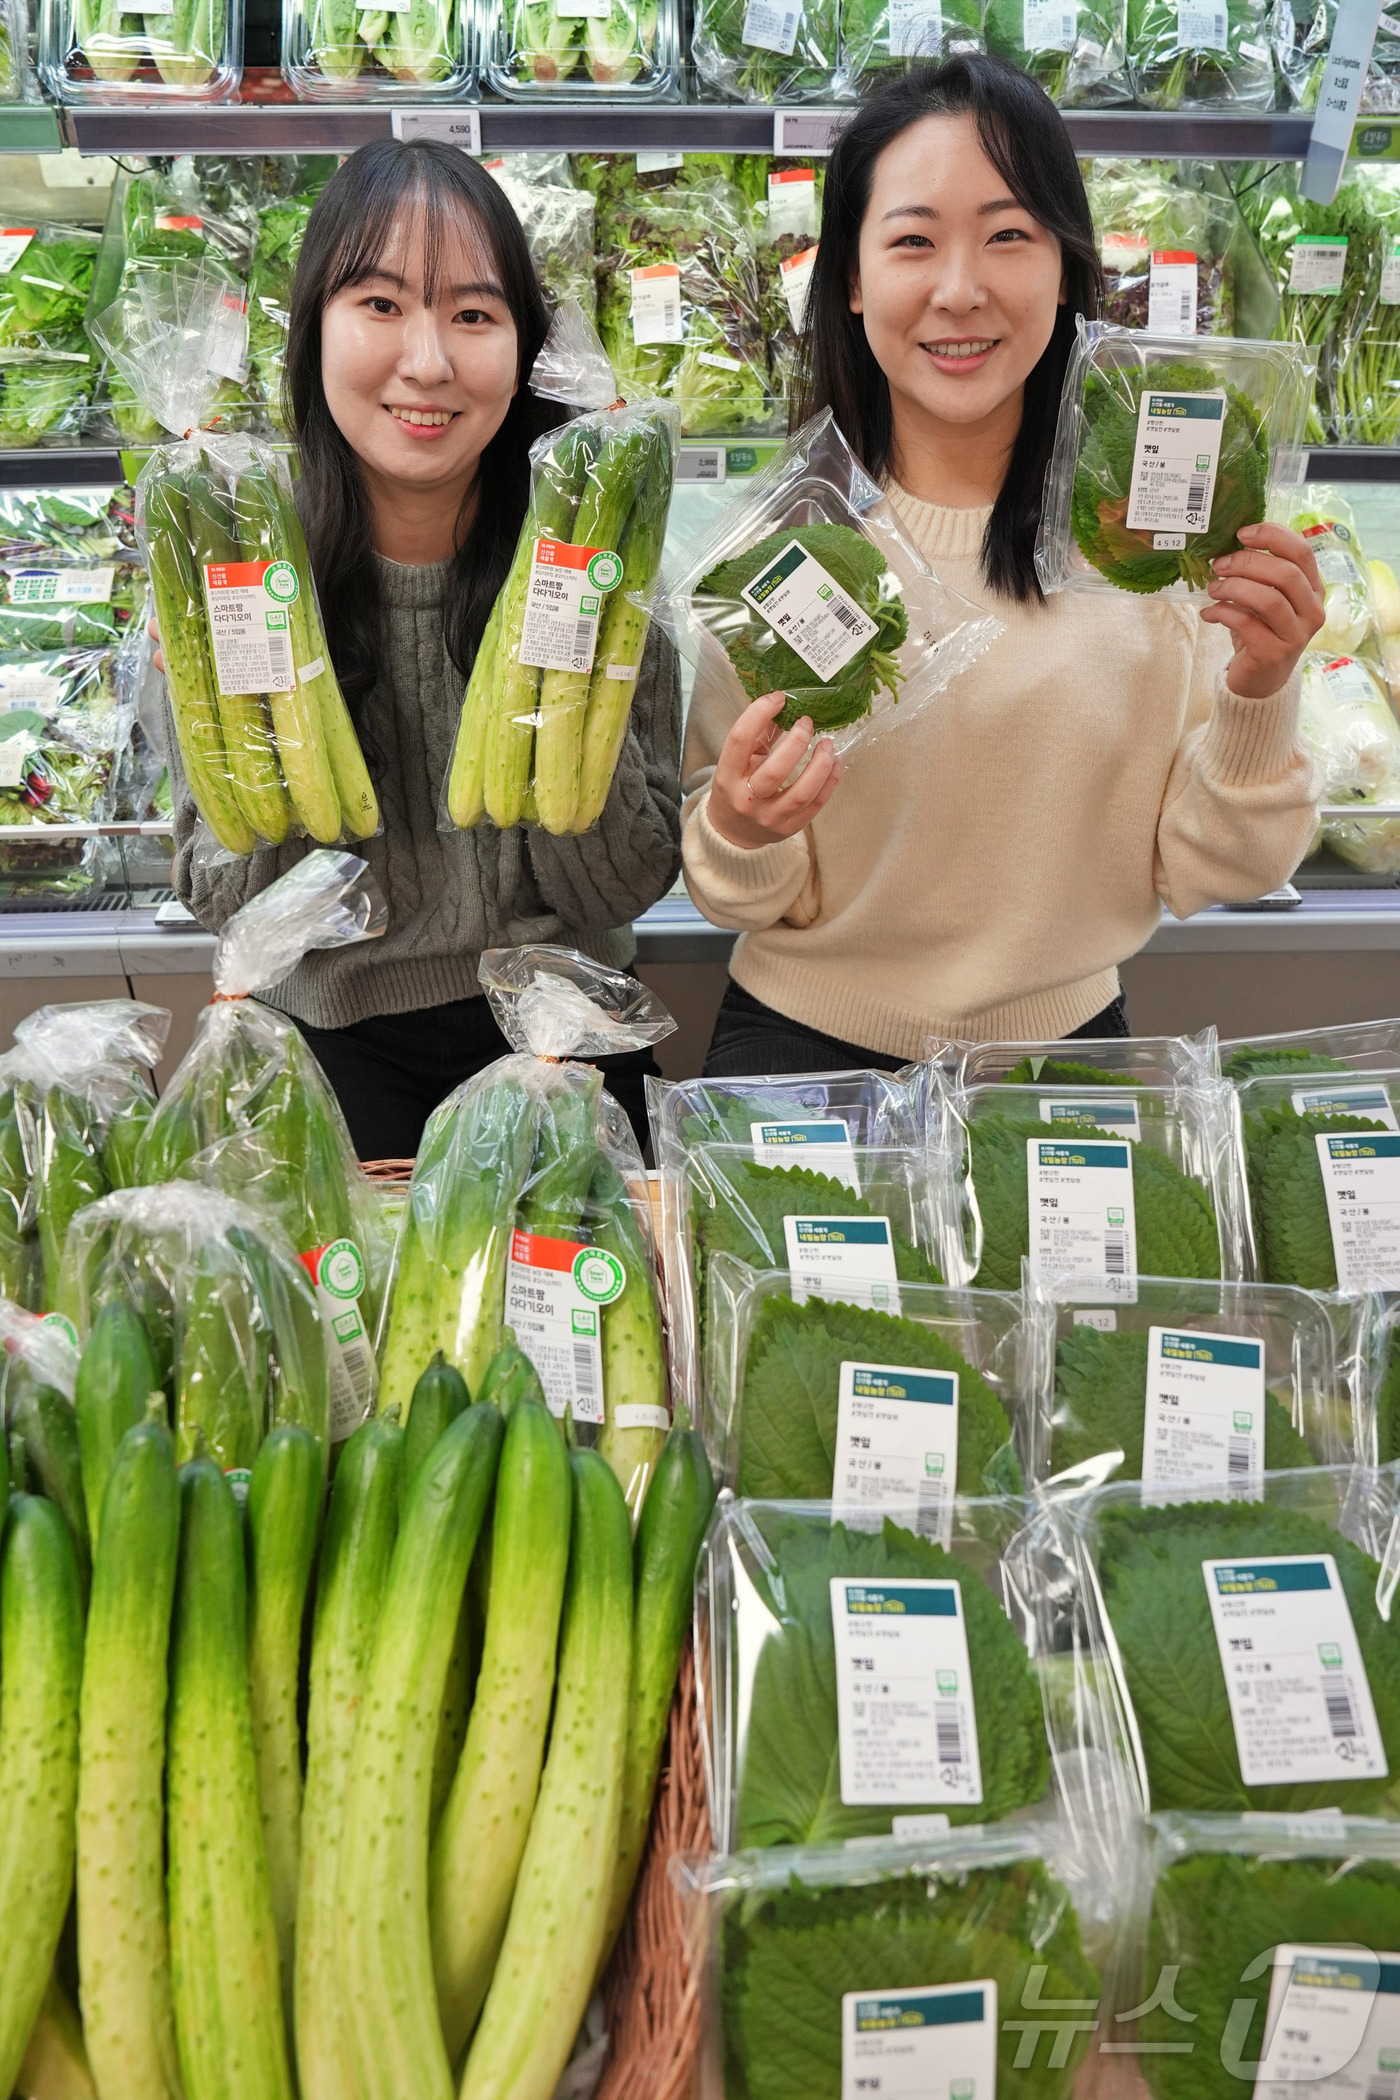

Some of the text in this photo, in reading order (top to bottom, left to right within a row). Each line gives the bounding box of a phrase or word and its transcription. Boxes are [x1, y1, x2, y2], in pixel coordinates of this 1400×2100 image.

[449, 125, 471, 134] 4,590
[1144, 444, 1159, 454] 깻잎
[698, 459, 717, 467] 2,990
[533, 578, 563, 591] 스마트팜
[532, 587, 569, 601] 다다기오이
[213, 603, 244, 613] 스마트팜
[530, 601, 541, 610] 국산
[214, 612, 252, 623] 다다기오이
[777, 612, 792, 627] 깻잎
[1337, 1189, 1356, 1200] 깻잎
[1039, 1198, 1058, 1208] 깻잎
[510, 1283, 545, 1301] 스마트팜
[510, 1296, 554, 1316] 다다기오이
[509, 1317, 522, 1329] 국산
[1159, 1393, 1179, 1406] 깻잎
[850, 1435, 870, 1448] 깻잎
